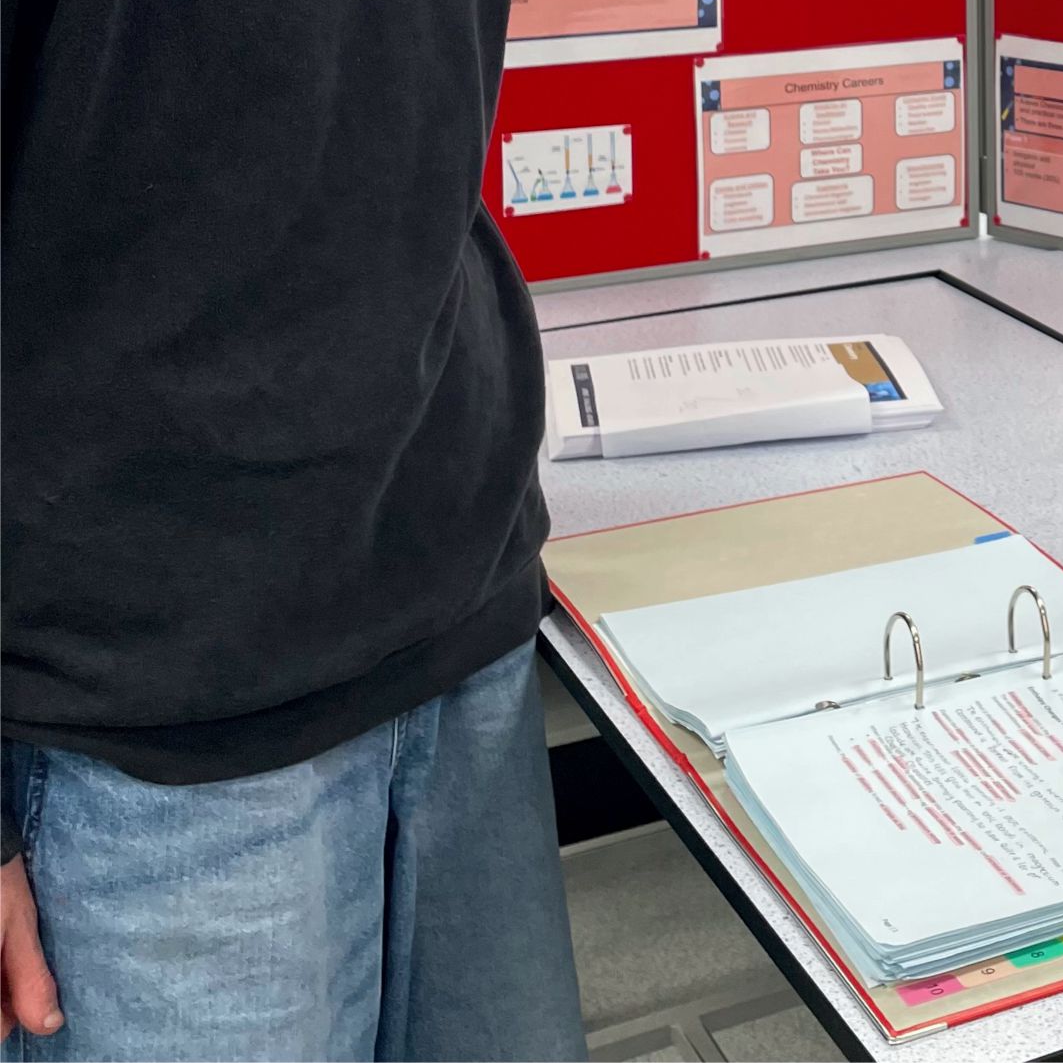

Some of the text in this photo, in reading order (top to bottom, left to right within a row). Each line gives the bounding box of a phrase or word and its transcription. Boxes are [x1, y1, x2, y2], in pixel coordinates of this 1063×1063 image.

[784, 76, 884, 94] Chemistry Careers
[1030, 950, 1044, 958] 8
[981, 966, 996, 976] 9
[926, 982, 944, 996] 10
